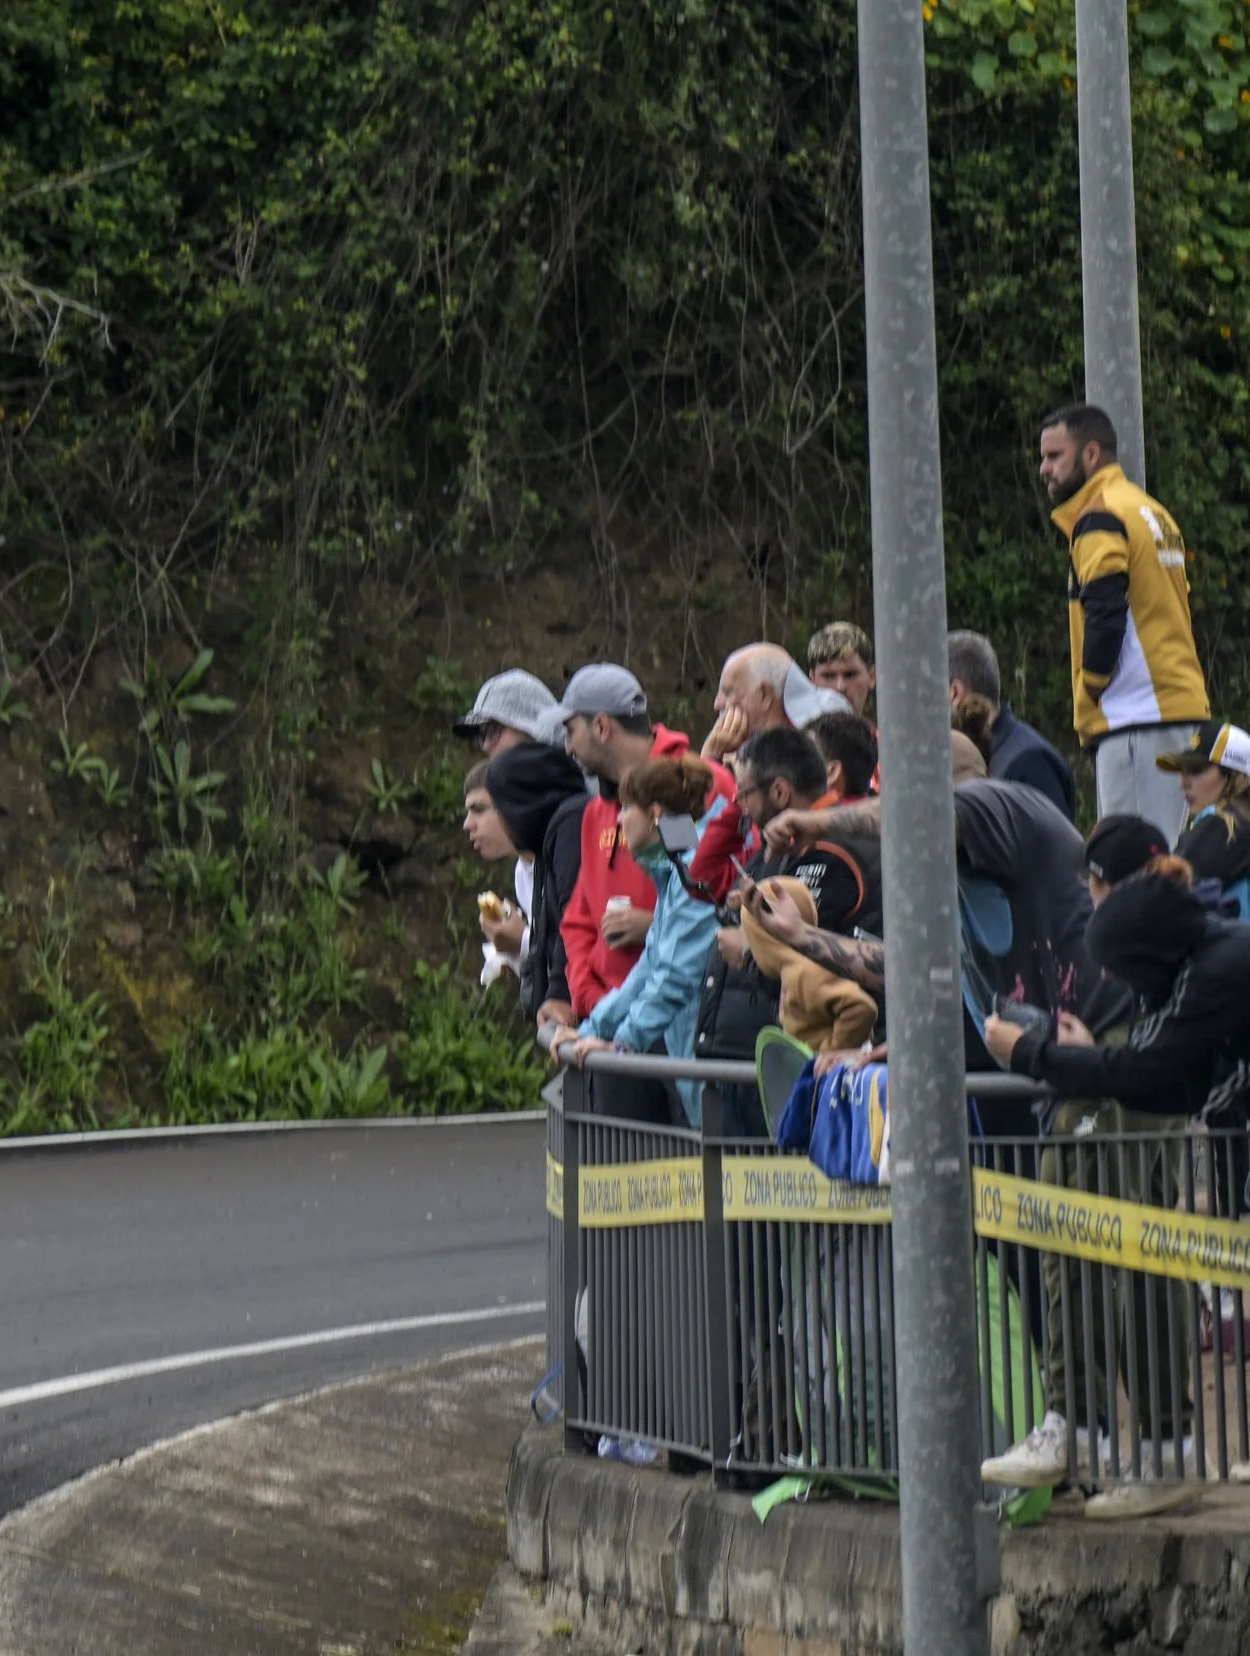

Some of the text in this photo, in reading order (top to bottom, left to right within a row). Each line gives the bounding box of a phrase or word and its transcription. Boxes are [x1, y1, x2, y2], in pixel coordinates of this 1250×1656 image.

[744, 1169, 771, 1206] ZONA
[773, 1169, 817, 1208] PUBLICO
[1017, 1191, 1055, 1238] ZONA
[1056, 1201, 1122, 1252] PUBLICO
[1140, 1220, 1183, 1263] ZONA
